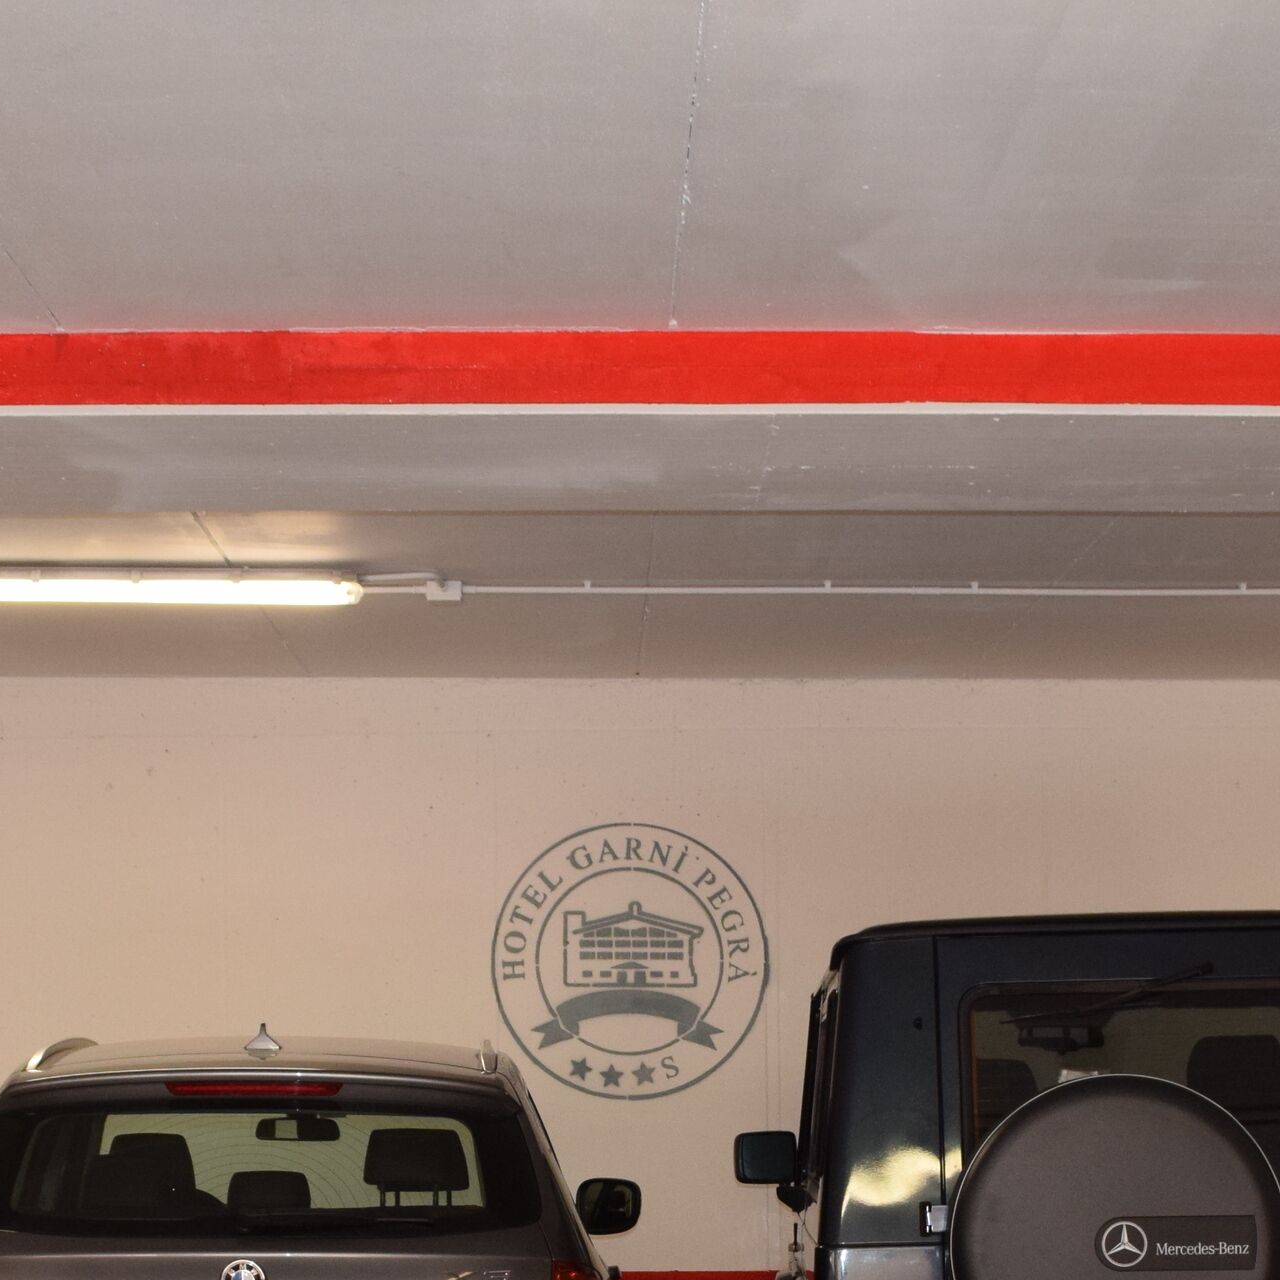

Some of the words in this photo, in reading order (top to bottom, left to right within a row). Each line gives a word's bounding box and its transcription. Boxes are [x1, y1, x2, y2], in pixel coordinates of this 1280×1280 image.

[502, 869, 563, 982] HOTEL
[661, 1056, 680, 1079] S
[1155, 1241, 1250, 1256] Mercedes-Benz
